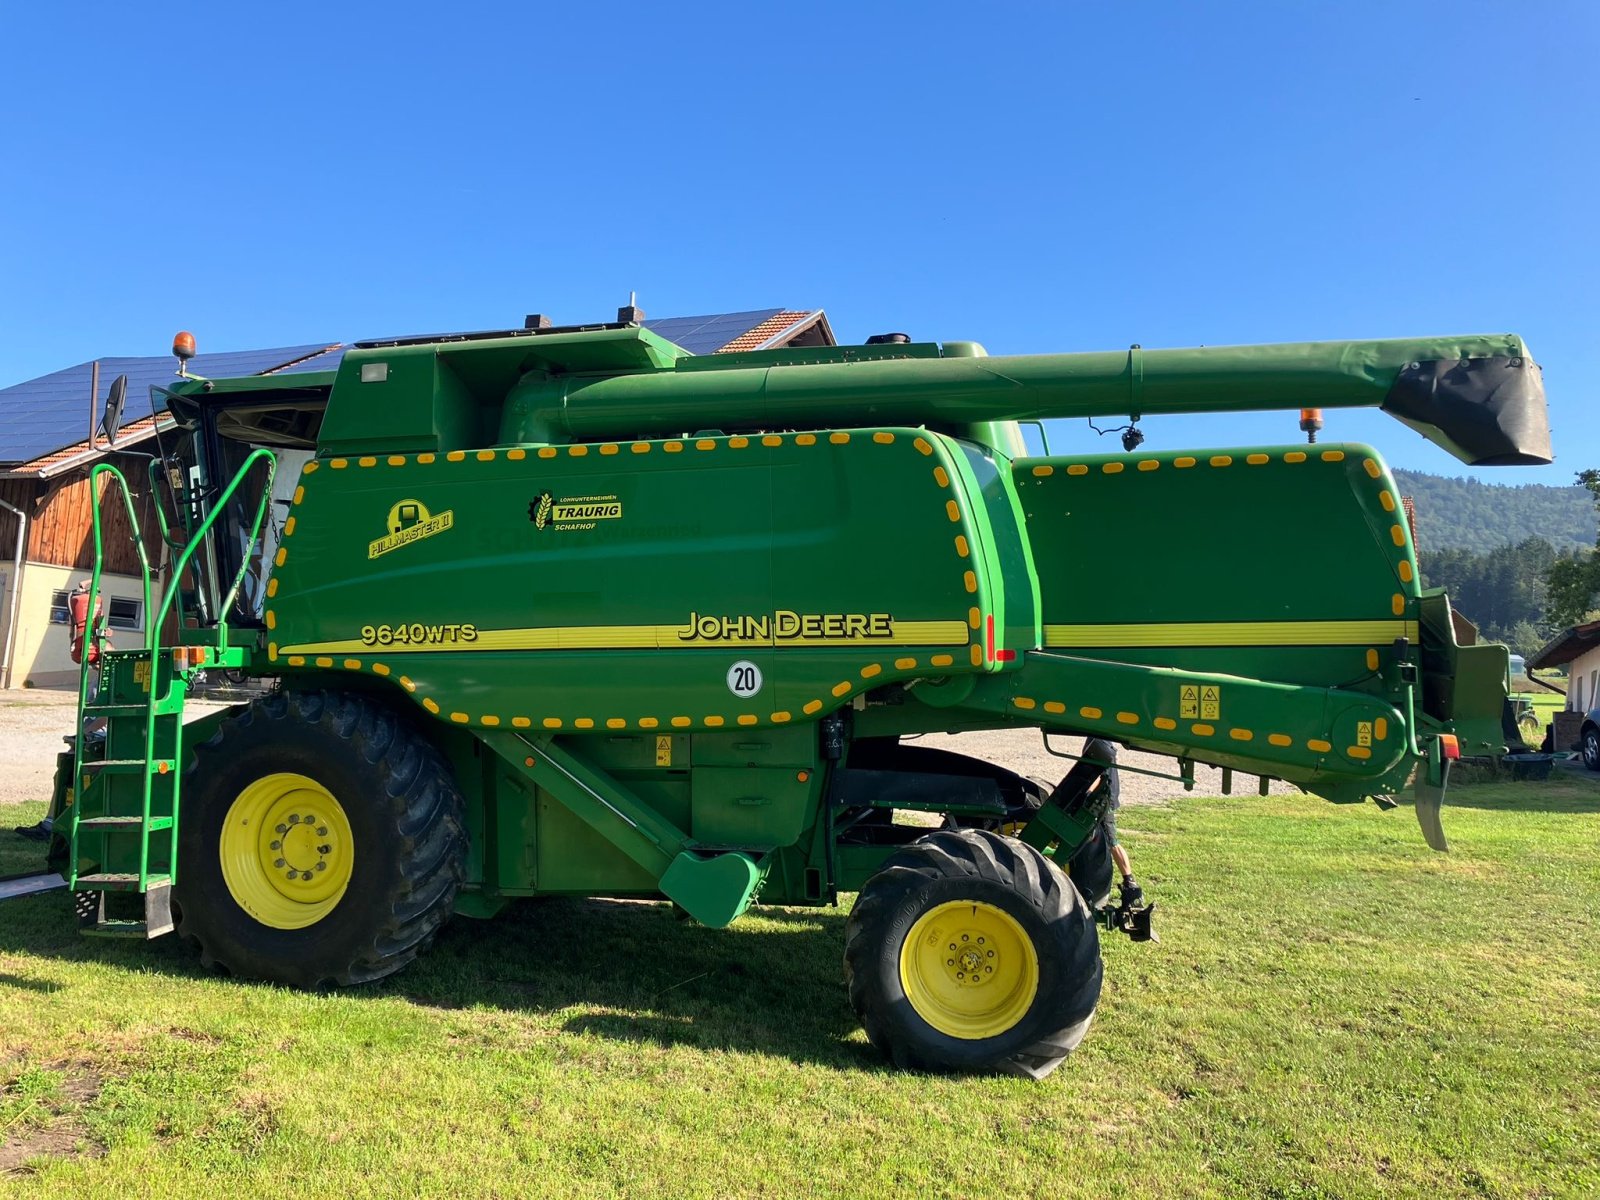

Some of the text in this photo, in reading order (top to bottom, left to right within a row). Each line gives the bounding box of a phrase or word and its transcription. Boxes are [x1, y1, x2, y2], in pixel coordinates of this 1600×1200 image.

[560, 495, 617, 503] LOHNUNTERNEHMEN
[557, 505, 619, 518] TRAURIG
[371, 514, 450, 556] HILLMASTER II
[554, 523, 596, 531] SCHAFHOF
[361, 623, 478, 646] 9640WTS
[678, 610, 893, 639] JOHN DEERE
[734, 667, 756, 691] 20
